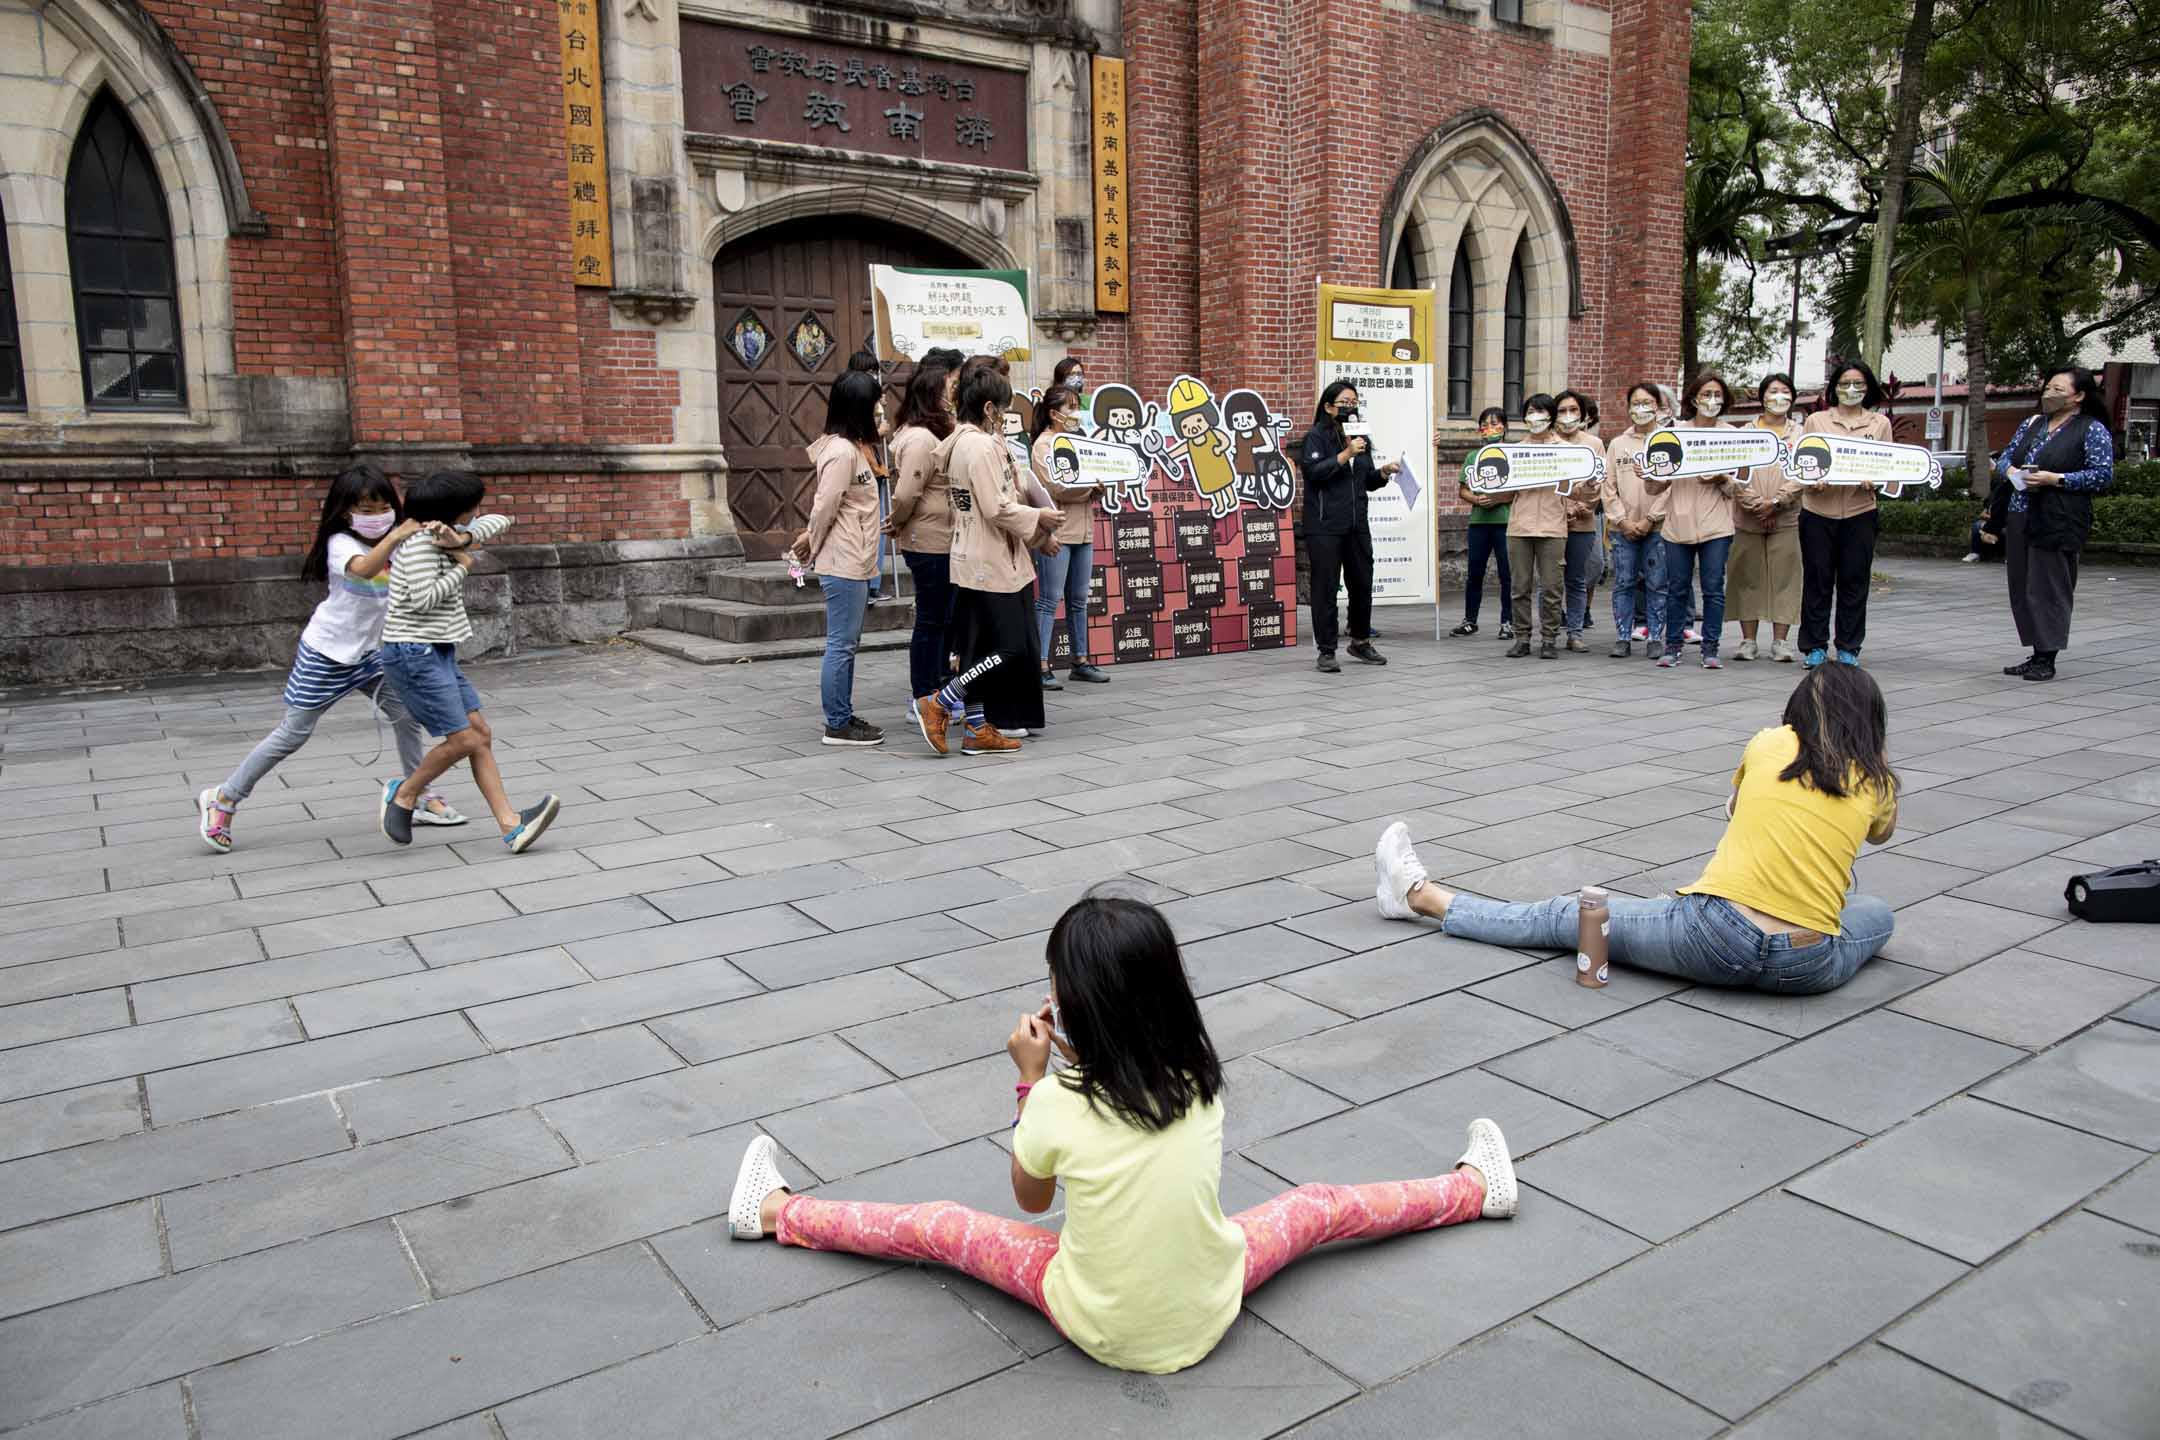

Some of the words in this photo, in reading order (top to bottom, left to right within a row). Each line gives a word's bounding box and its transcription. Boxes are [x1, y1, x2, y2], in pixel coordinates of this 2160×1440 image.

[721, 79, 996, 153] 濟南教會
[565, 28, 602, 276] 台北國語禮拜堂
[1101, 111, 1122, 296] 濟南基督長老教會
[1127, 576, 1159, 588] 社會住宅
[1125, 627, 1142, 638] 公民
[1175, 621, 1211, 636] 政治代理人
[1058, 634, 1069, 645] 18
[1185, 634, 1201, 644] 公約
